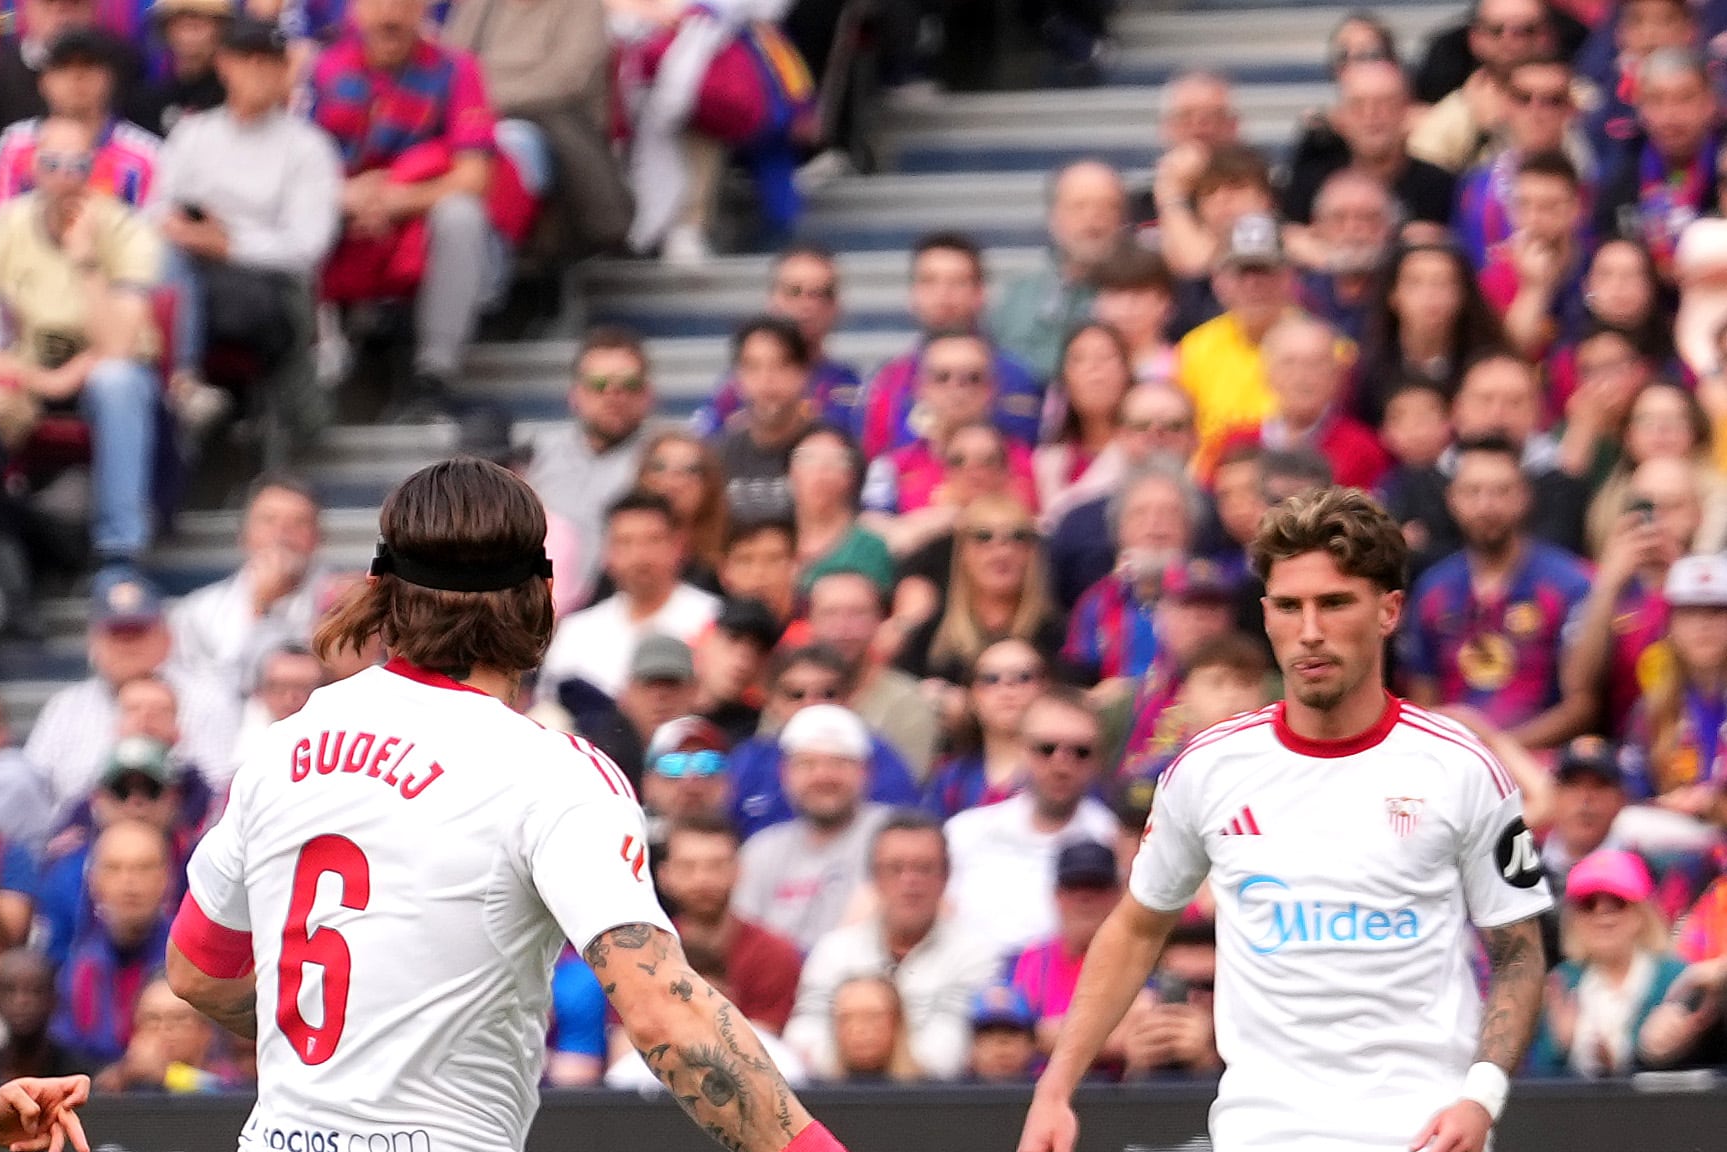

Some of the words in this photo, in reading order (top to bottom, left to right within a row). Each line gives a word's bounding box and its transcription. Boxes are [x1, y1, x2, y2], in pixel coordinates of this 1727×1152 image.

[290, 730, 445, 800] GUDELJ
[275, 833, 371, 1066] 6
[1248, 901, 1420, 955] Midea
